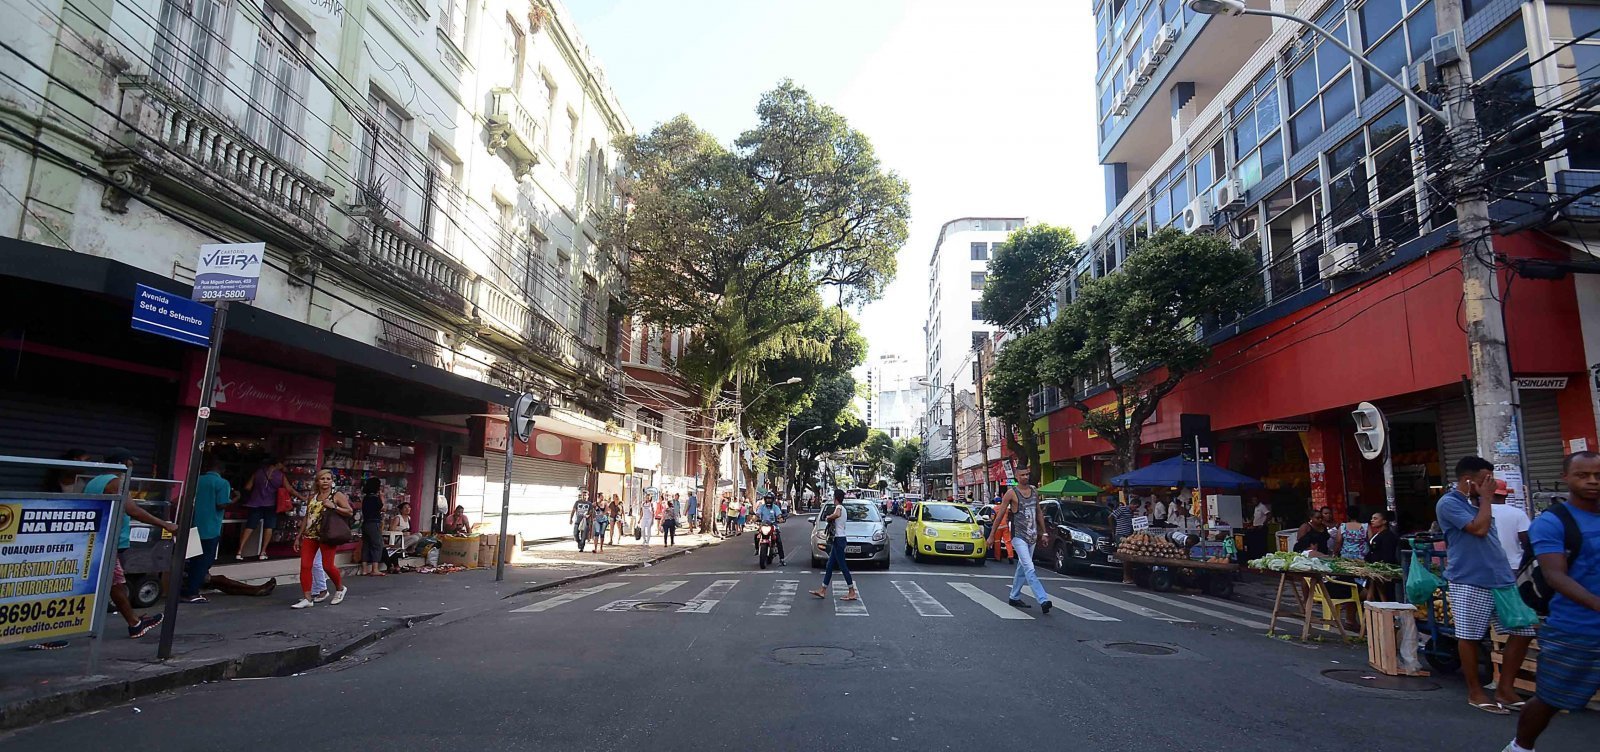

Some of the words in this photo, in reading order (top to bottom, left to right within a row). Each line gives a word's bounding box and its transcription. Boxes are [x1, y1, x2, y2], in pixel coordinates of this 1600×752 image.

[202, 249, 260, 270] VIEIRA
[141, 290, 169, 305] Avenida
[201, 290, 246, 299] 3034-5800
[139, 300, 157, 312] Sete
[158, 306, 168, 315] de
[169, 310, 203, 326] Setembro
[1517, 379, 1566, 387] NSINUANTE
[23, 511, 96, 520] DINHEIRO
[21, 522, 47, 532] NA
[50, 521, 96, 532] HORA
[1, 544, 45, 556] QUALQUER
[46, 543, 74, 553] OFERTA
[0, 559, 55, 579] MPRÉSTIMO
[54, 557, 79, 576] FÁCIL,
[0, 581, 16, 597] EM
[15, 577, 74, 596] BUROCRACIA
[0, 596, 86, 625] 8690-6214
